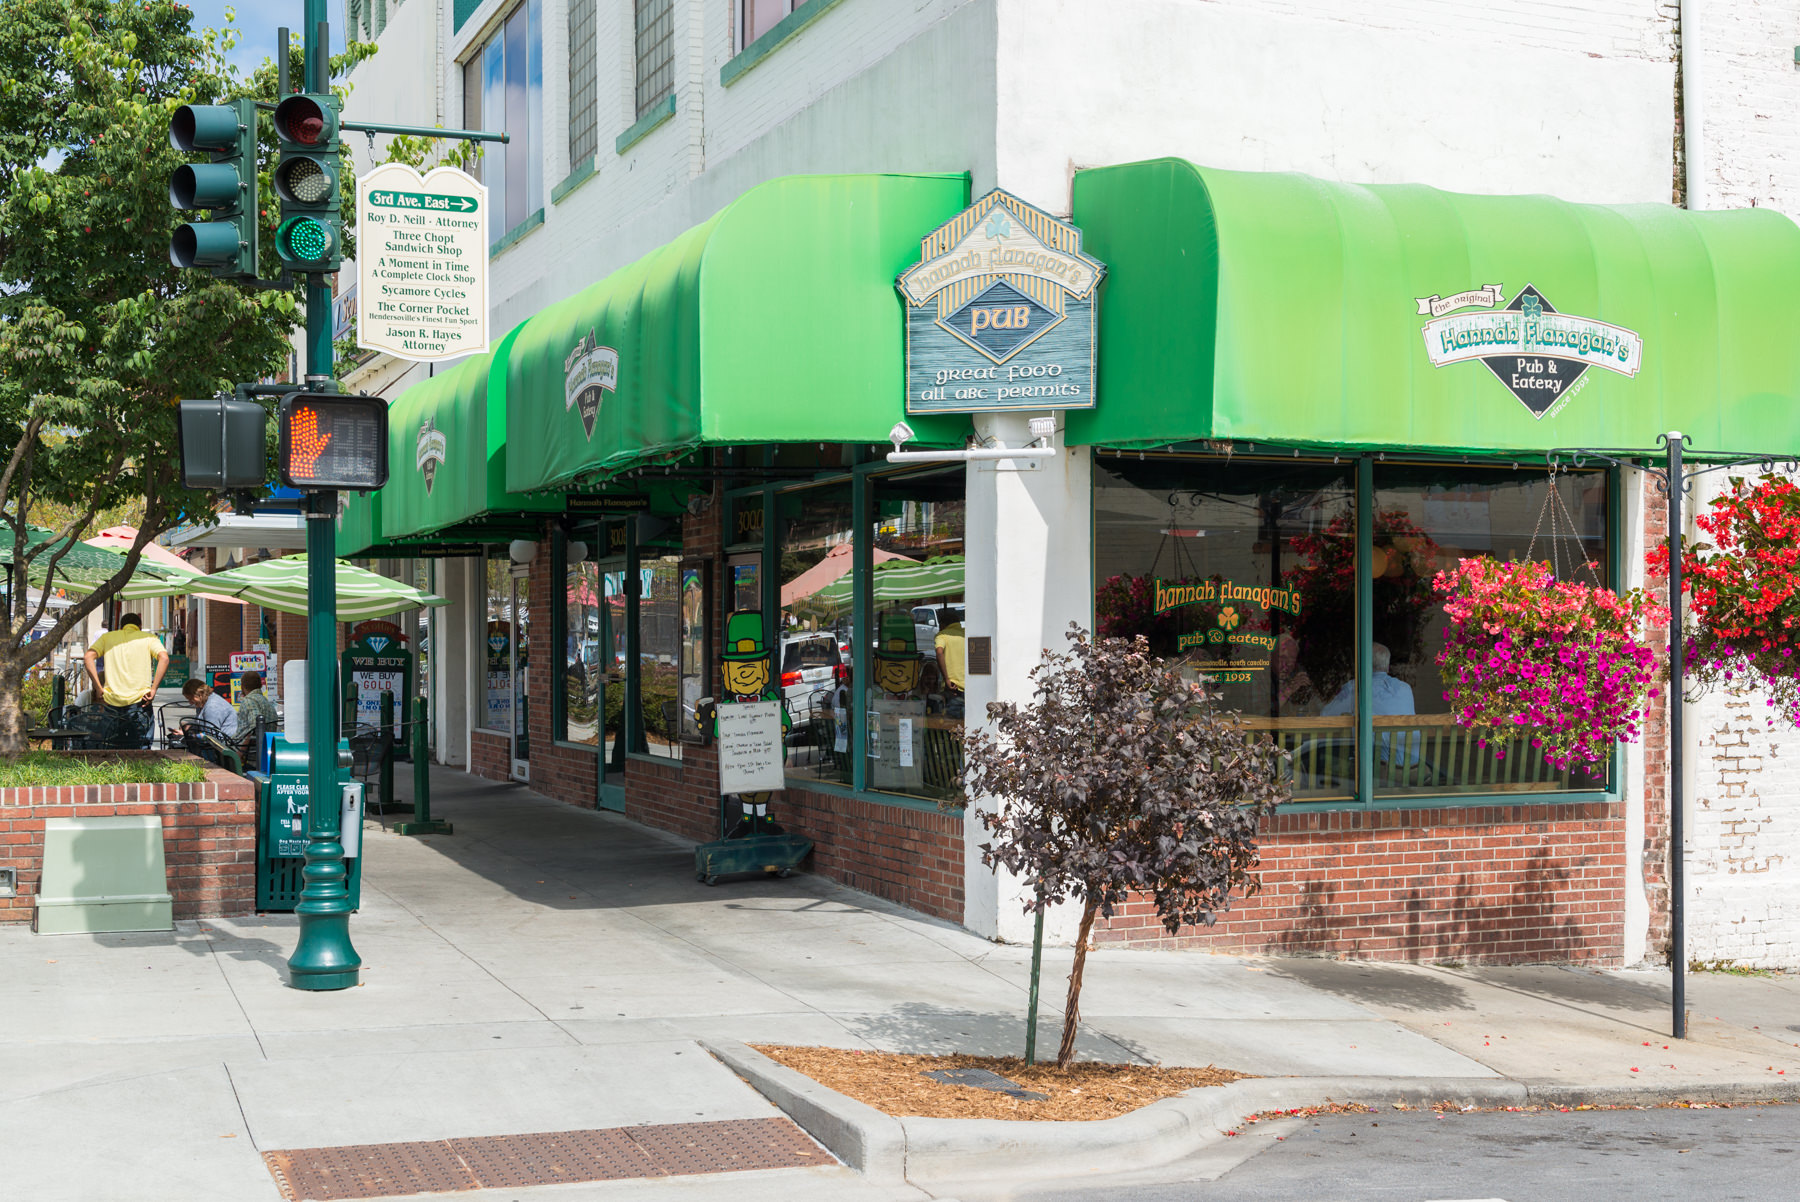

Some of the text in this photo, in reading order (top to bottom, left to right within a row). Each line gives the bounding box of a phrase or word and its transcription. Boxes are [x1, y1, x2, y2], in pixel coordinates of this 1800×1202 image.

[373, 192, 451, 210] 3rd Ave. East
[367, 212, 480, 231] Roy D. Neill Attorney
[392, 230, 455, 245] Three Chopt
[385, 241, 463, 258] Sandwich Shop
[378, 257, 470, 272] A Moment in Time
[372, 269, 476, 285] A Complete Clock Shop
[381, 284, 467, 300] Sycamore Cycles
[377, 301, 470, 316] The Corner Pocket
[1435, 294, 1492, 313] the original
[422, 315, 443, 323] Finest
[444, 317, 458, 325] Fun
[459, 318, 478, 326] Sport
[385, 327, 462, 342] Jason R. Hayes
[1441, 321, 1631, 362] Hannah Flanagan's
[401, 340, 447, 353] Attorney
[1517, 358, 1558, 374] Pub &
[1512, 373, 1563, 394] Eatery
[1571, 376, 1591, 397] 1993
[920, 387, 947, 401] all
[352, 656, 405, 666] WE BUY
[360, 672, 396, 680] WE BUY
[1225, 672, 1252, 682] 1993
[363, 680, 392, 690] GOLD
